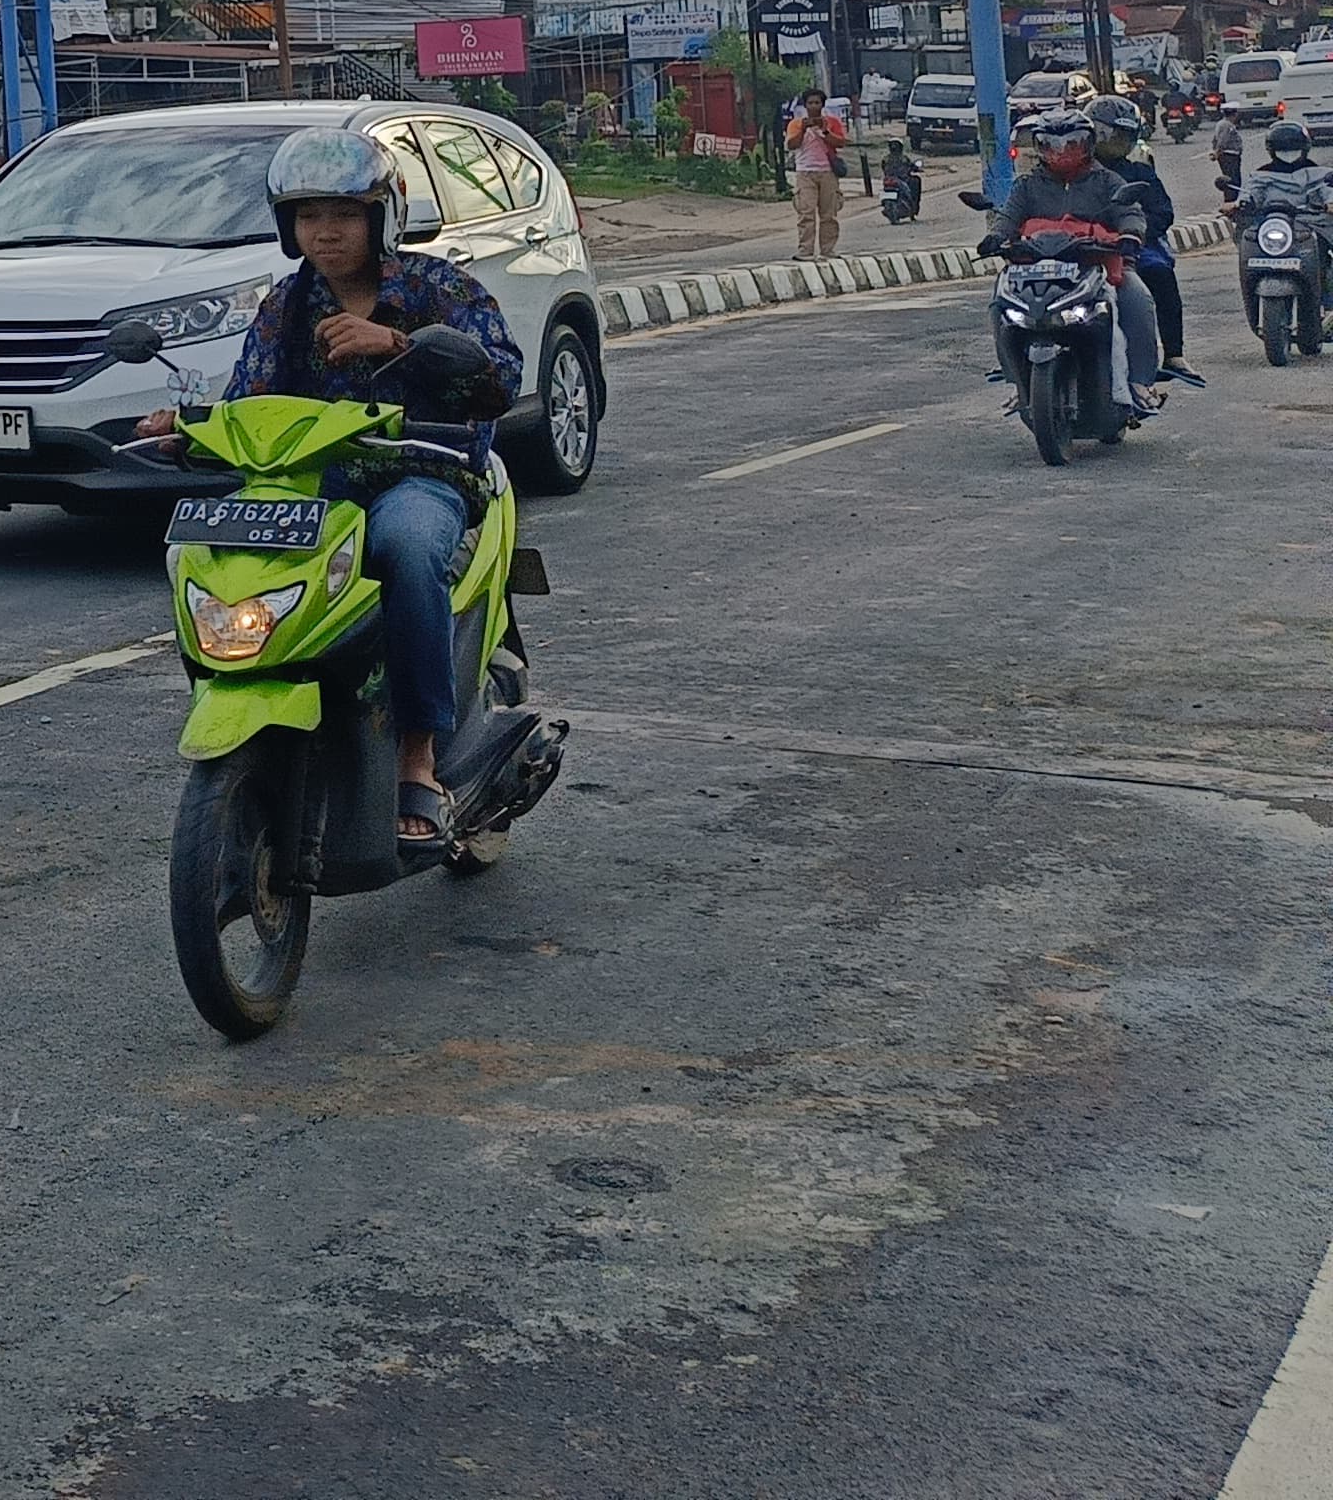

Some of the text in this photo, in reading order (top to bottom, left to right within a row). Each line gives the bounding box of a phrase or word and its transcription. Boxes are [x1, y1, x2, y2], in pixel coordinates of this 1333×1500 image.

[652, 28, 677, 37] Safety
[436, 51, 504, 64] BHINNIAN
[177, 502, 207, 521] DA
